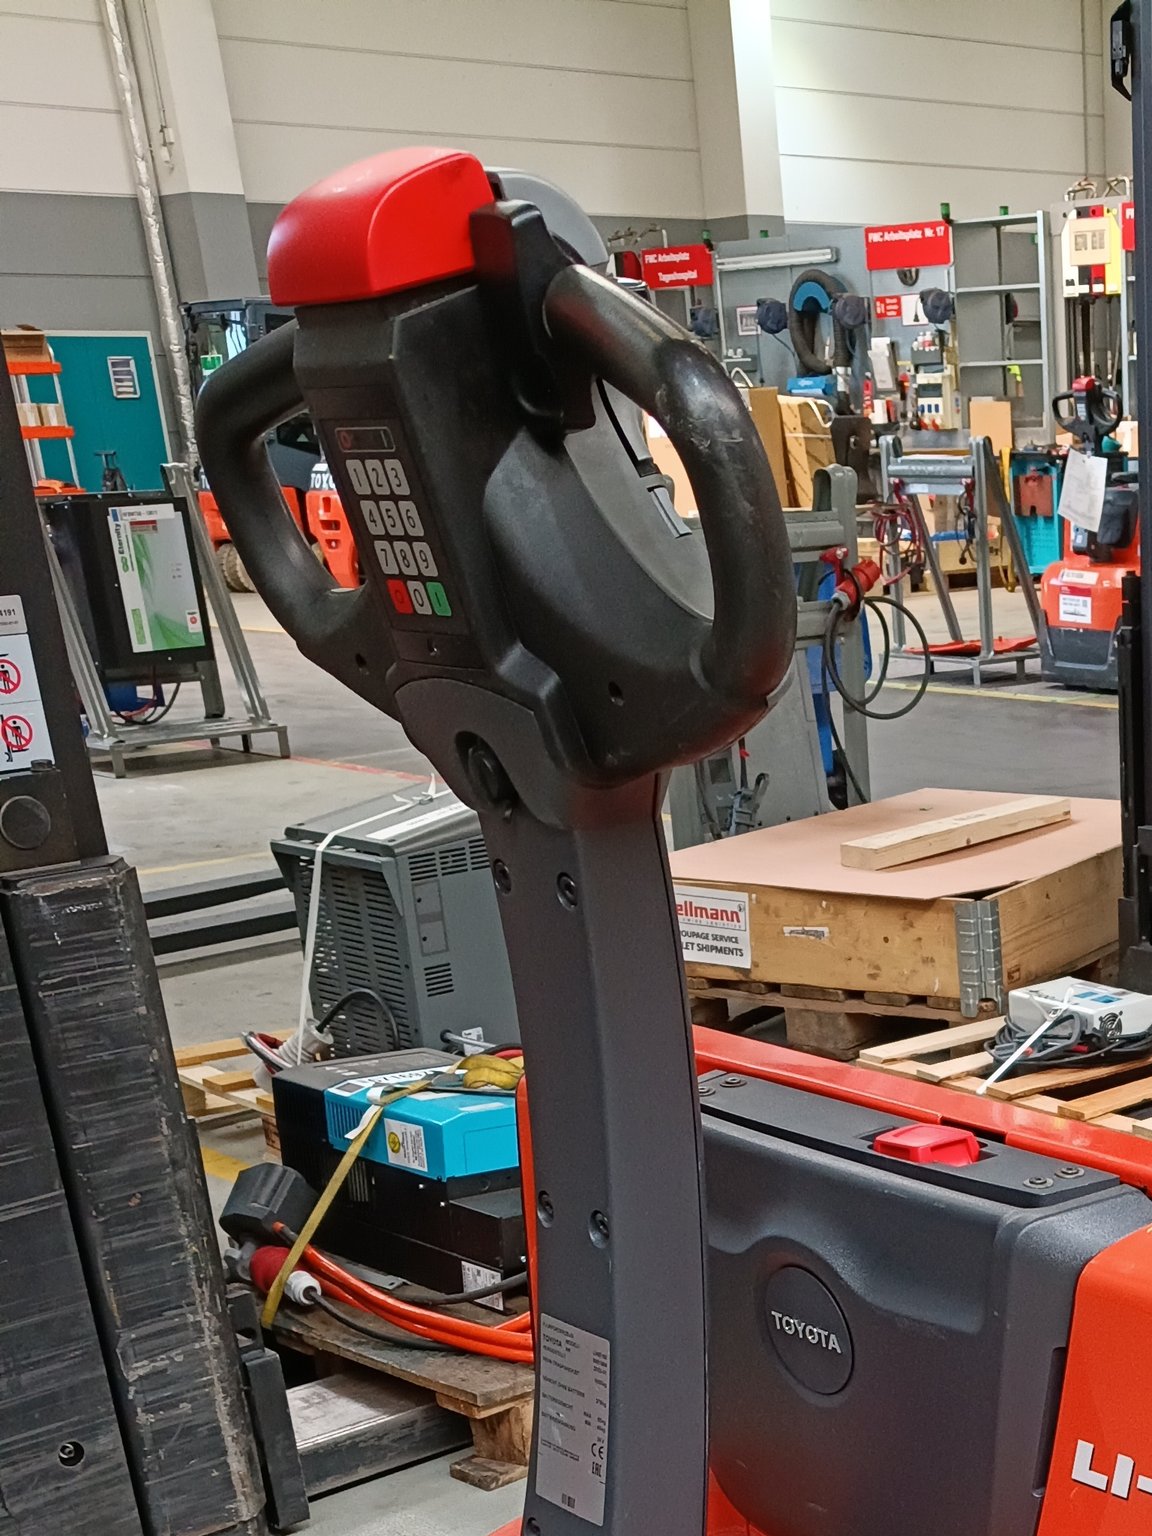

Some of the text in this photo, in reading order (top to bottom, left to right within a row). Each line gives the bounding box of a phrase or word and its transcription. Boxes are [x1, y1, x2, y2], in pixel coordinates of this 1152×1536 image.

[371, 468, 383, 488] 2
[391, 467, 402, 488] 3
[368, 508, 416, 529] 4 5 6
[380, 548, 429, 570] 7 8 9
[413, 588, 424, 607] 0
[675, 900, 741, 923] ellmann
[681, 930, 739, 944] OUPAGE SERVICE
[696, 942, 744, 957] SHIPMENTS
[771, 1310, 842, 1354] TOYOTA
